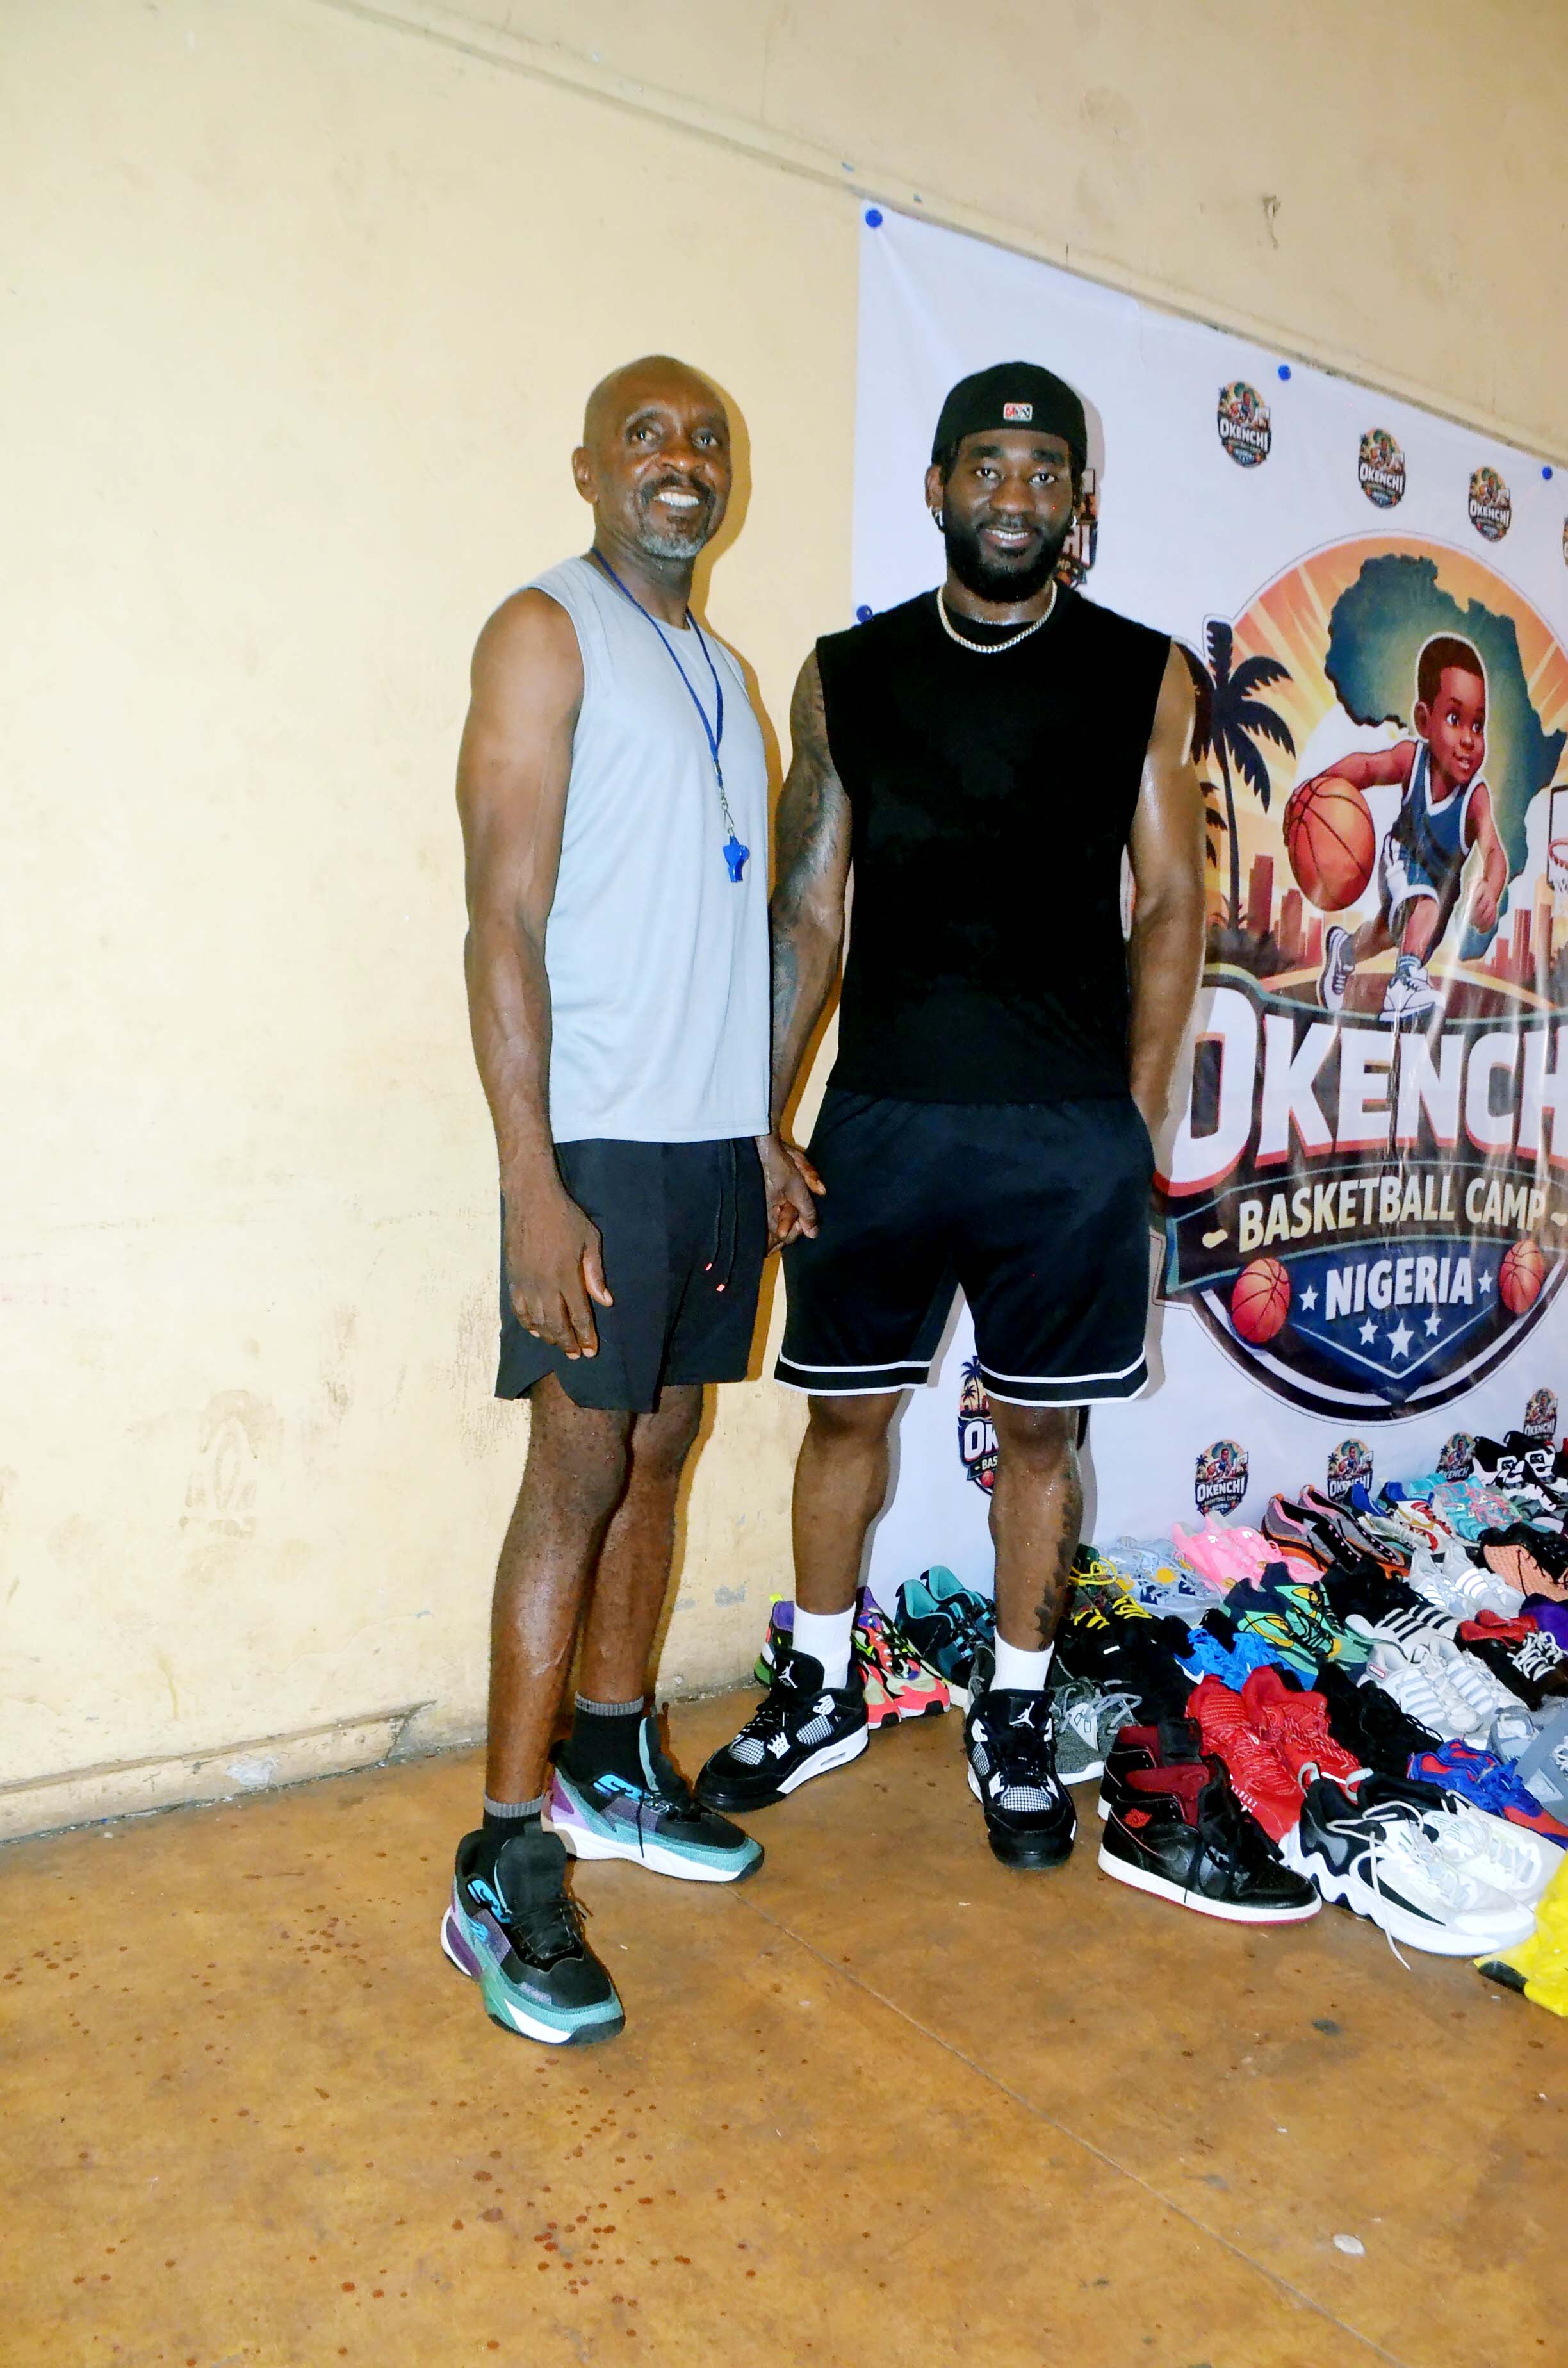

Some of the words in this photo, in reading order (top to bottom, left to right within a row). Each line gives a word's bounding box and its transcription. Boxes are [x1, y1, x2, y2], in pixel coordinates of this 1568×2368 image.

[1220, 418, 1268, 452] OKENCHI
[1359, 463, 1403, 494] OKENCHI
[1469, 500, 1510, 528] OKENCHI
[1239, 1174, 1455, 1253] BASKETBALL
[1465, 1176, 1546, 1232] CAMP
[1325, 1256, 1474, 1321] NIGERIA
[1196, 1476, 1245, 1502] OKENCHI
